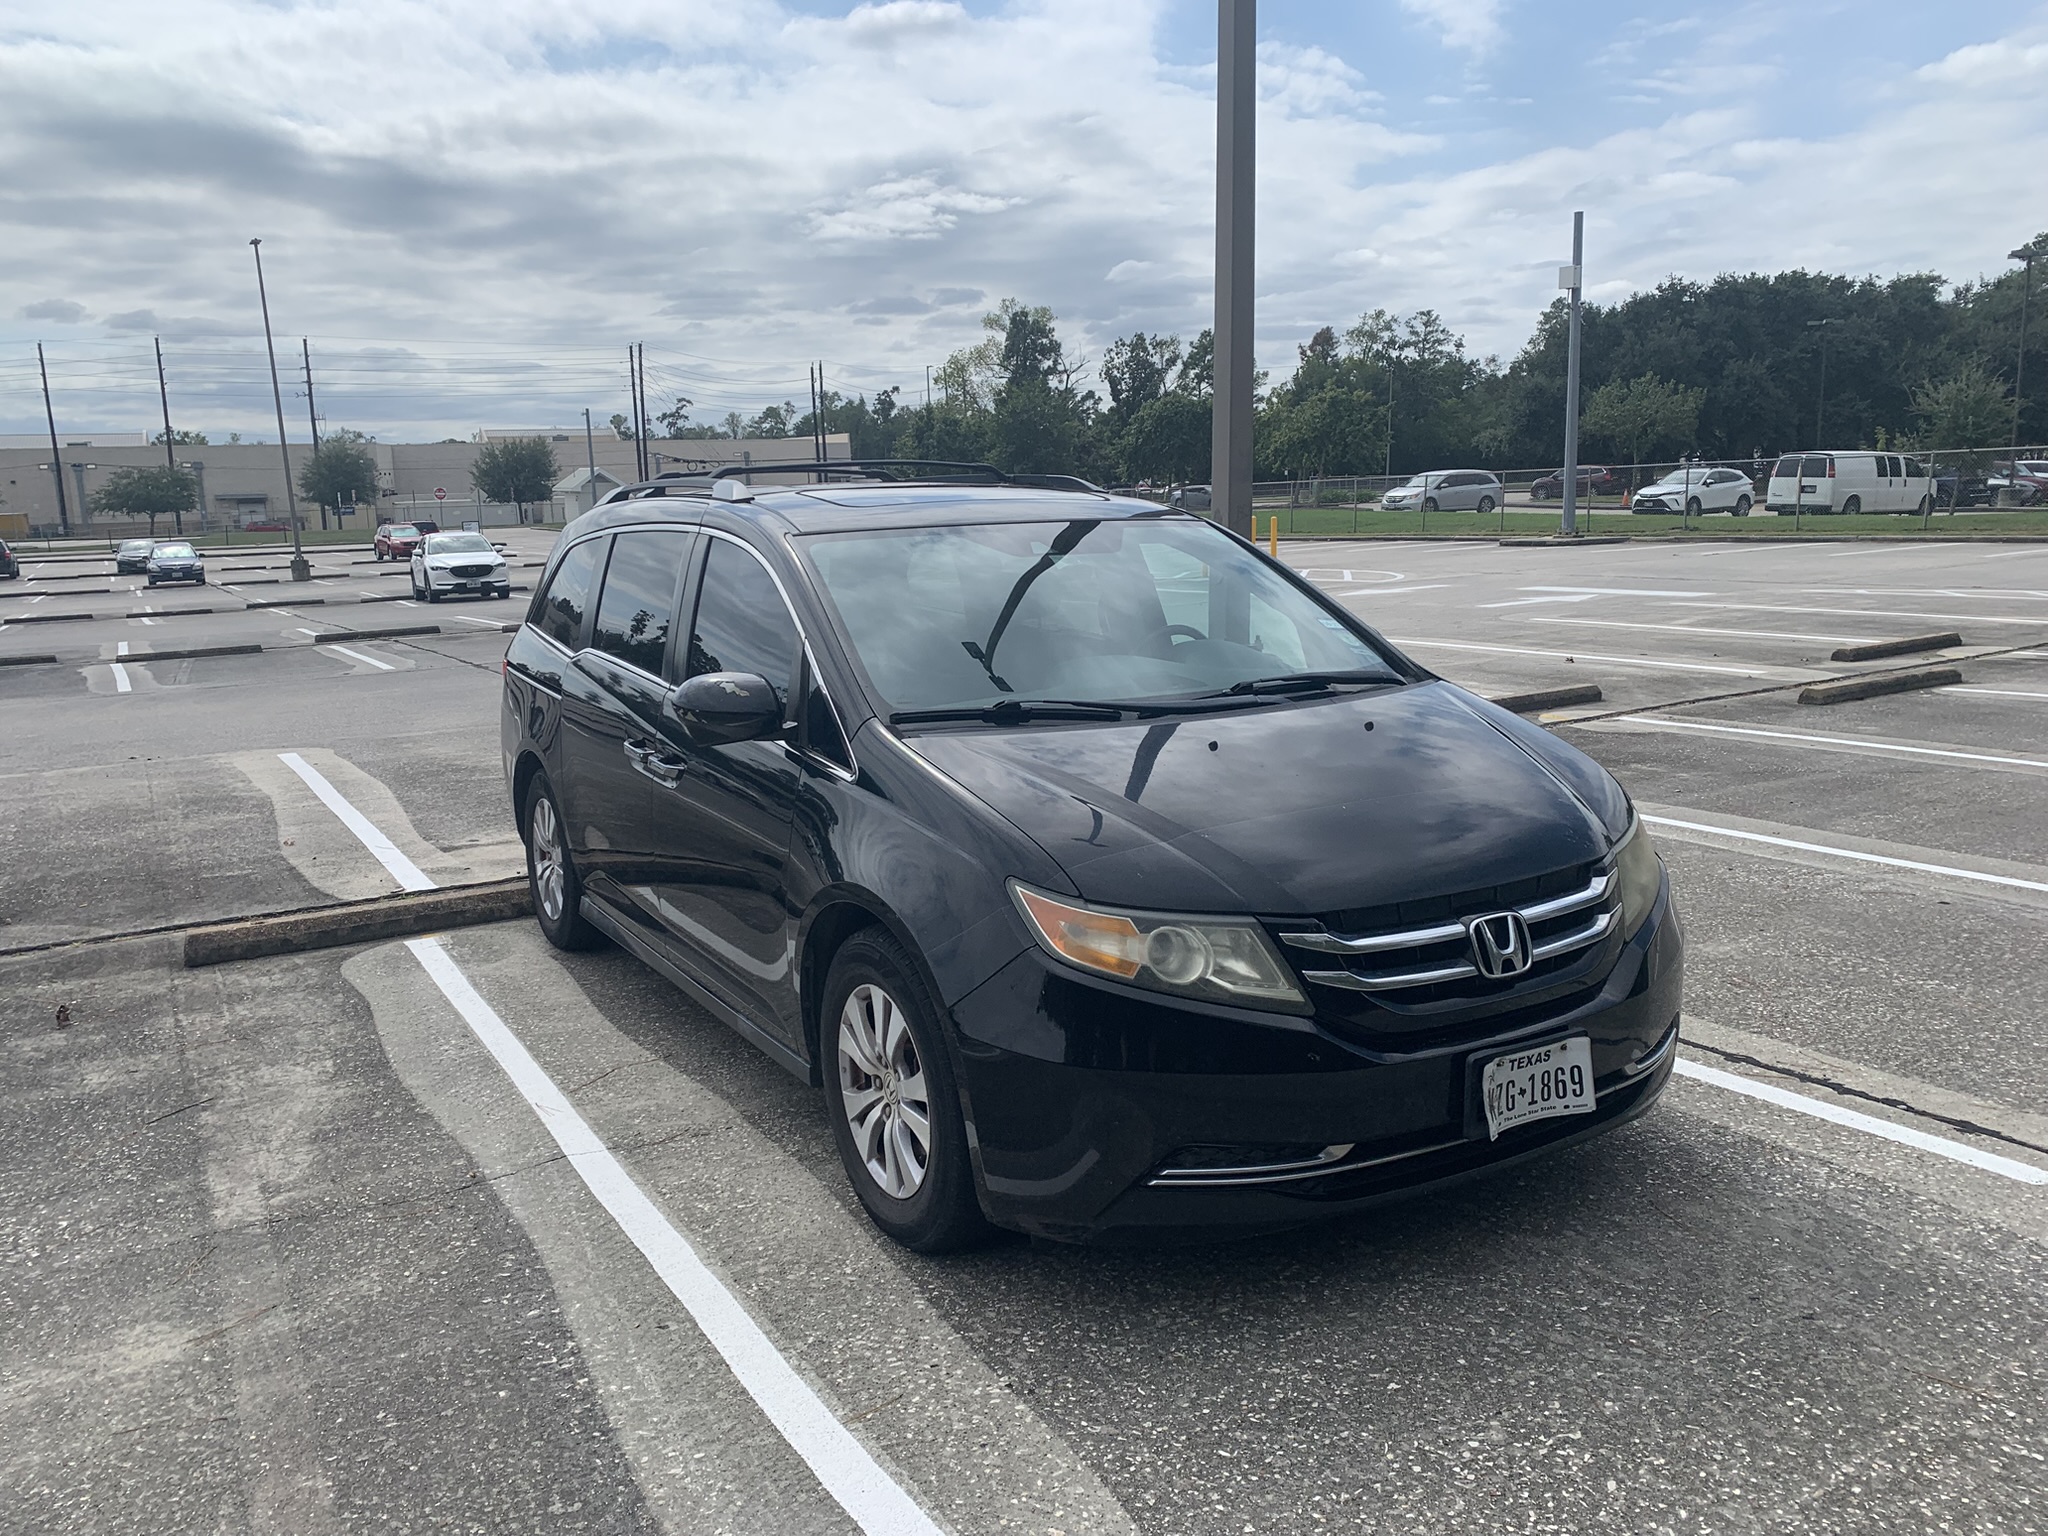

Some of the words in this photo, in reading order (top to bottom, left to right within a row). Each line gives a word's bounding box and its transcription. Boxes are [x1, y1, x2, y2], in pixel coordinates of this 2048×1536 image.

[1508, 1050, 1551, 1072] TEXAS
[1527, 1064, 1585, 1107] 1869
[1514, 1112, 1527, 1120] Lone
